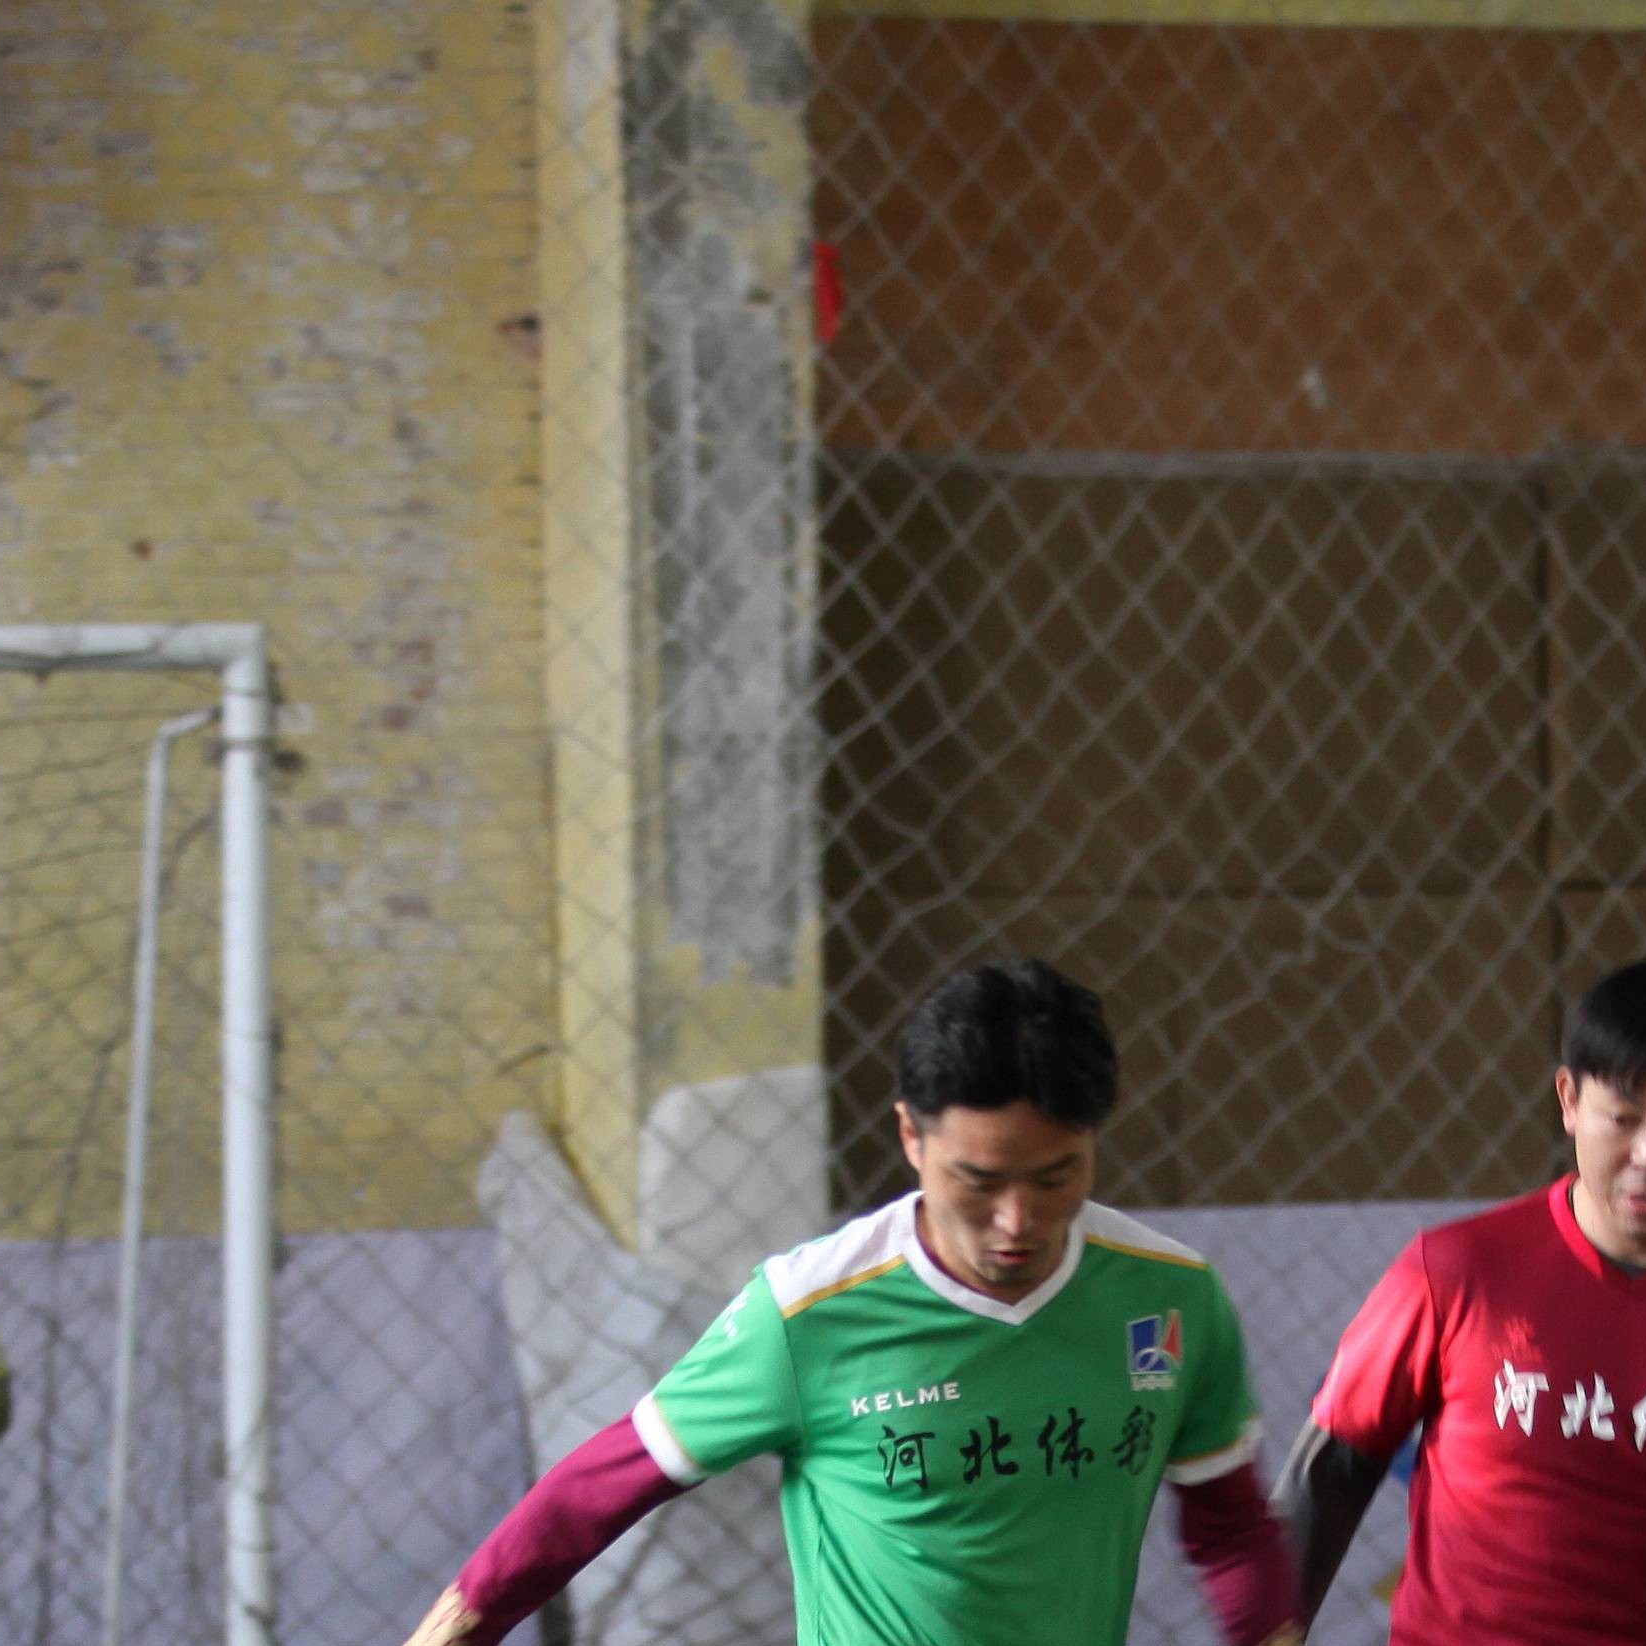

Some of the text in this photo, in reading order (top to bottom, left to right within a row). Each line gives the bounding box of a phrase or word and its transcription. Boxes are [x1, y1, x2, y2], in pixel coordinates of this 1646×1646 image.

[851, 1381, 962, 1417] KELME
[877, 1404, 1157, 1491] 河北体彩
